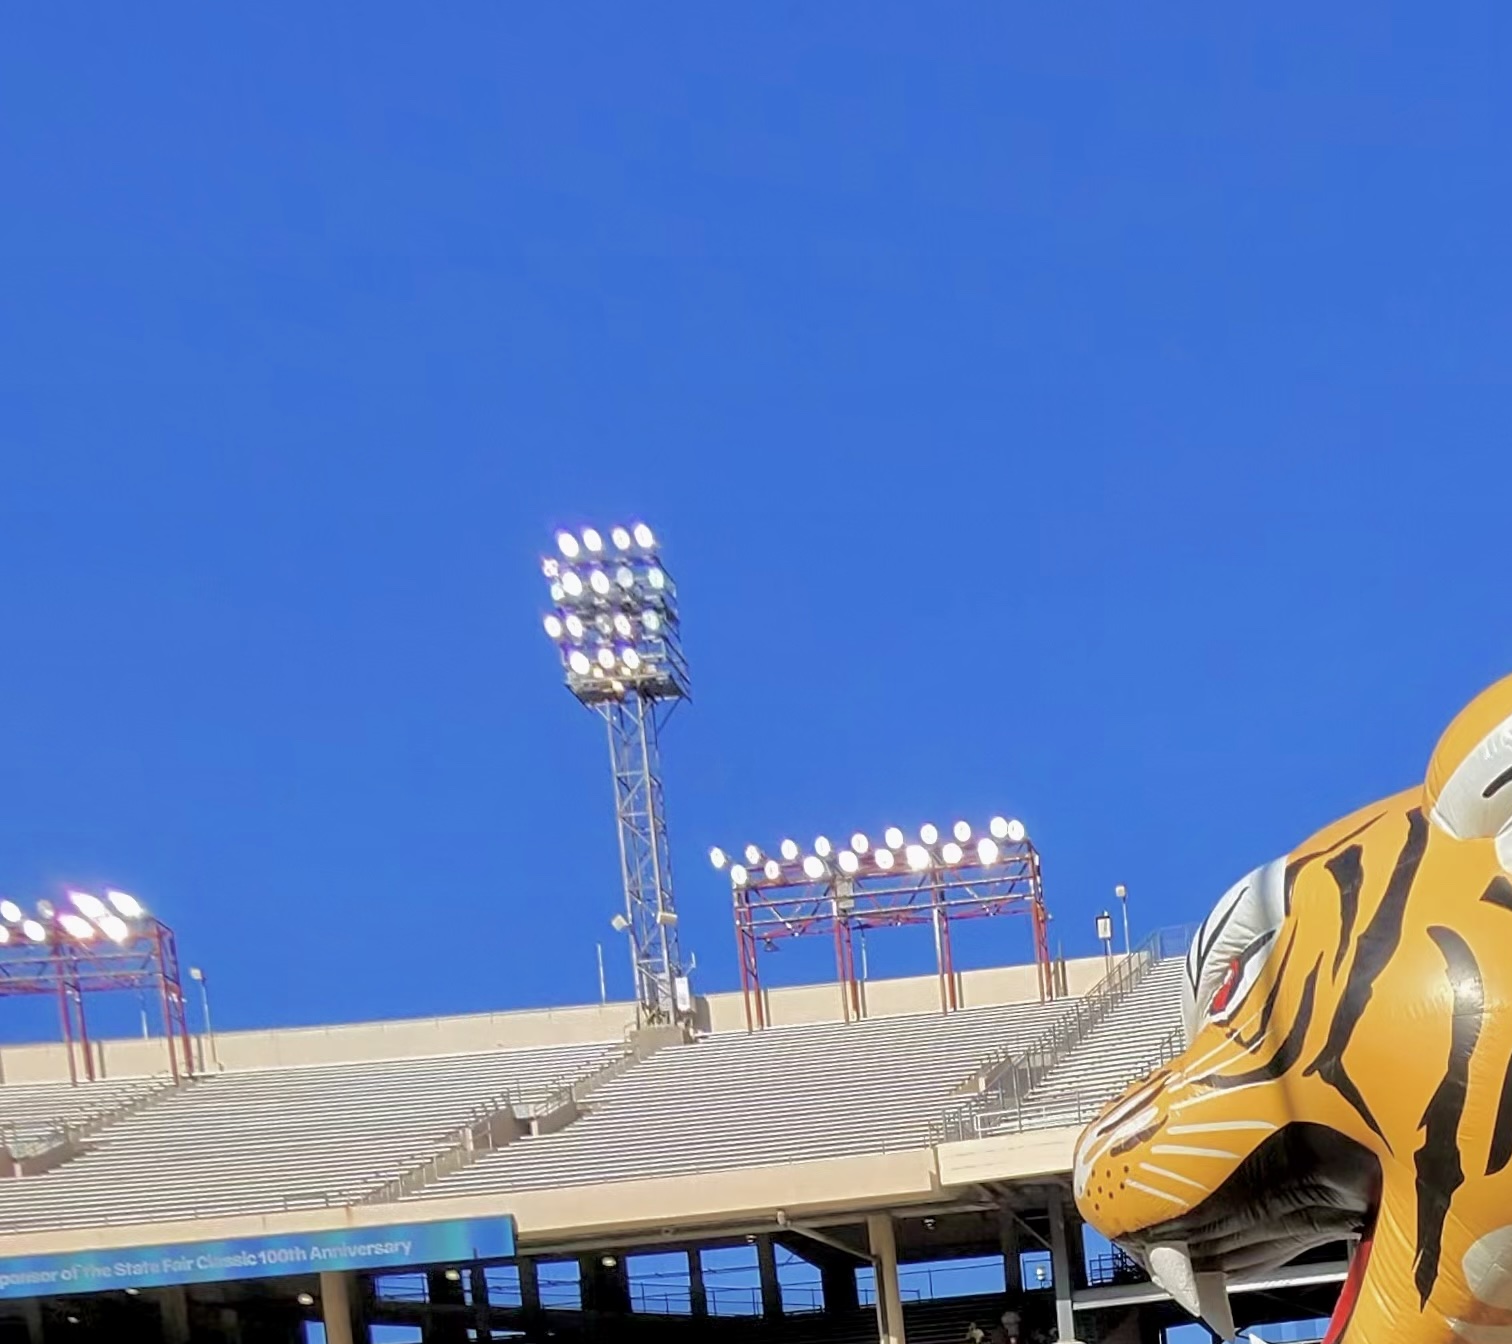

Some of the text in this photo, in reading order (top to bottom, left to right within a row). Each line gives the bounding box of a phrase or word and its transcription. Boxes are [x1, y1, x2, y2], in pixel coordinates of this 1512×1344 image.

[60, 1266, 79, 1281] of
[113, 1261, 161, 1277] State
[162, 1257, 194, 1273] Fair
[196, 1251, 257, 1270] Classic
[258, 1247, 307, 1266] 100th
[309, 1240, 412, 1260] Anniversary
